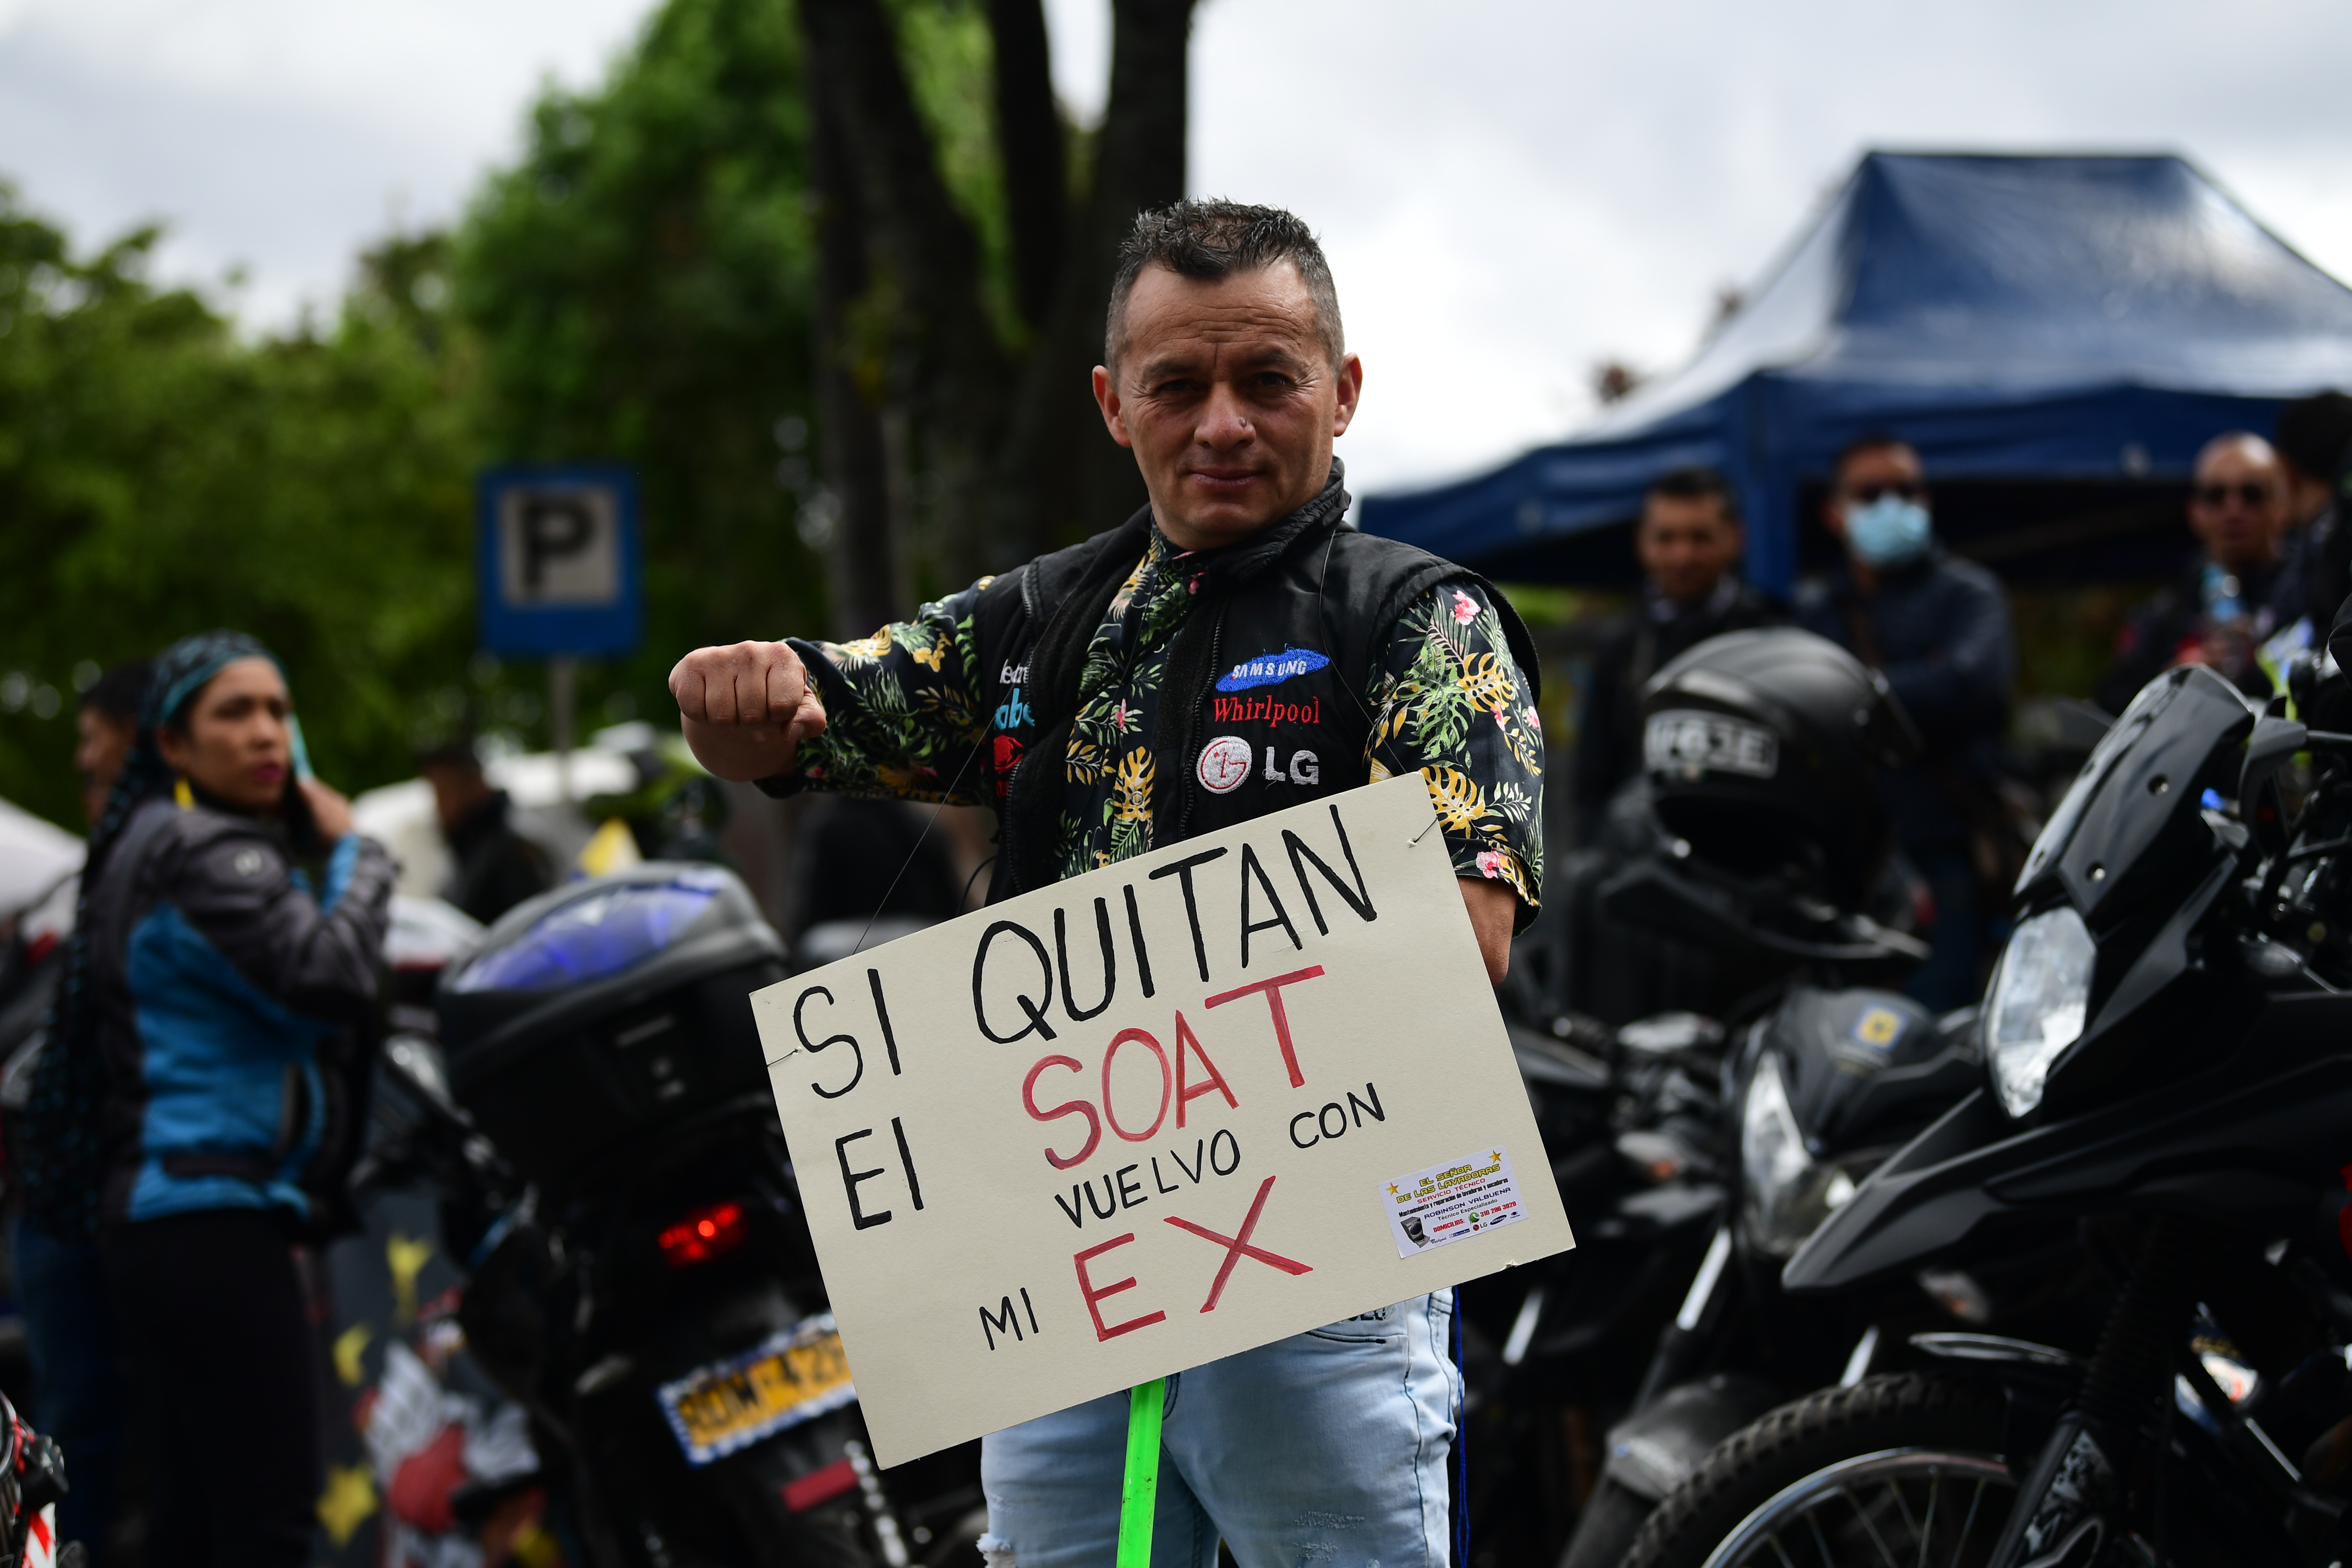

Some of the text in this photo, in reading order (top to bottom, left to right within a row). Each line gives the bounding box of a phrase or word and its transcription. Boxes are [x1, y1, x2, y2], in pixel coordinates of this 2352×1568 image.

[520, 498, 596, 595] P
[1232, 659, 1307, 680] SAMSUNG
[1213, 695, 1319, 728] Whirlpool
[1265, 746, 1319, 785] LG
[793, 804, 1377, 1099] SI QUITAN
[1023, 965, 1325, 1170] SOAT
[1054, 1083, 1385, 1228] VUELVO CON
[1396, 1164, 1500, 1203] DE LAS LAVADORAS
[1417, 1178, 1486, 1204] SERVICIO TÉCNICO
[1419, 1164, 1472, 1187] EL SEÑOR
[1399, 1204, 1429, 1217] Mantenimiento
[1462, 1186, 1483, 1197] lavadoras
[1487, 1178, 1508, 1188] secadoras
[1424, 1187, 1511, 1220] ROBINSON VALBUENA
[1460, 1199, 1497, 1214] Especializado
[1433, 1218, 1465, 1233] DOMICILIOS:
[979, 1176, 1313, 1350] MI EX
